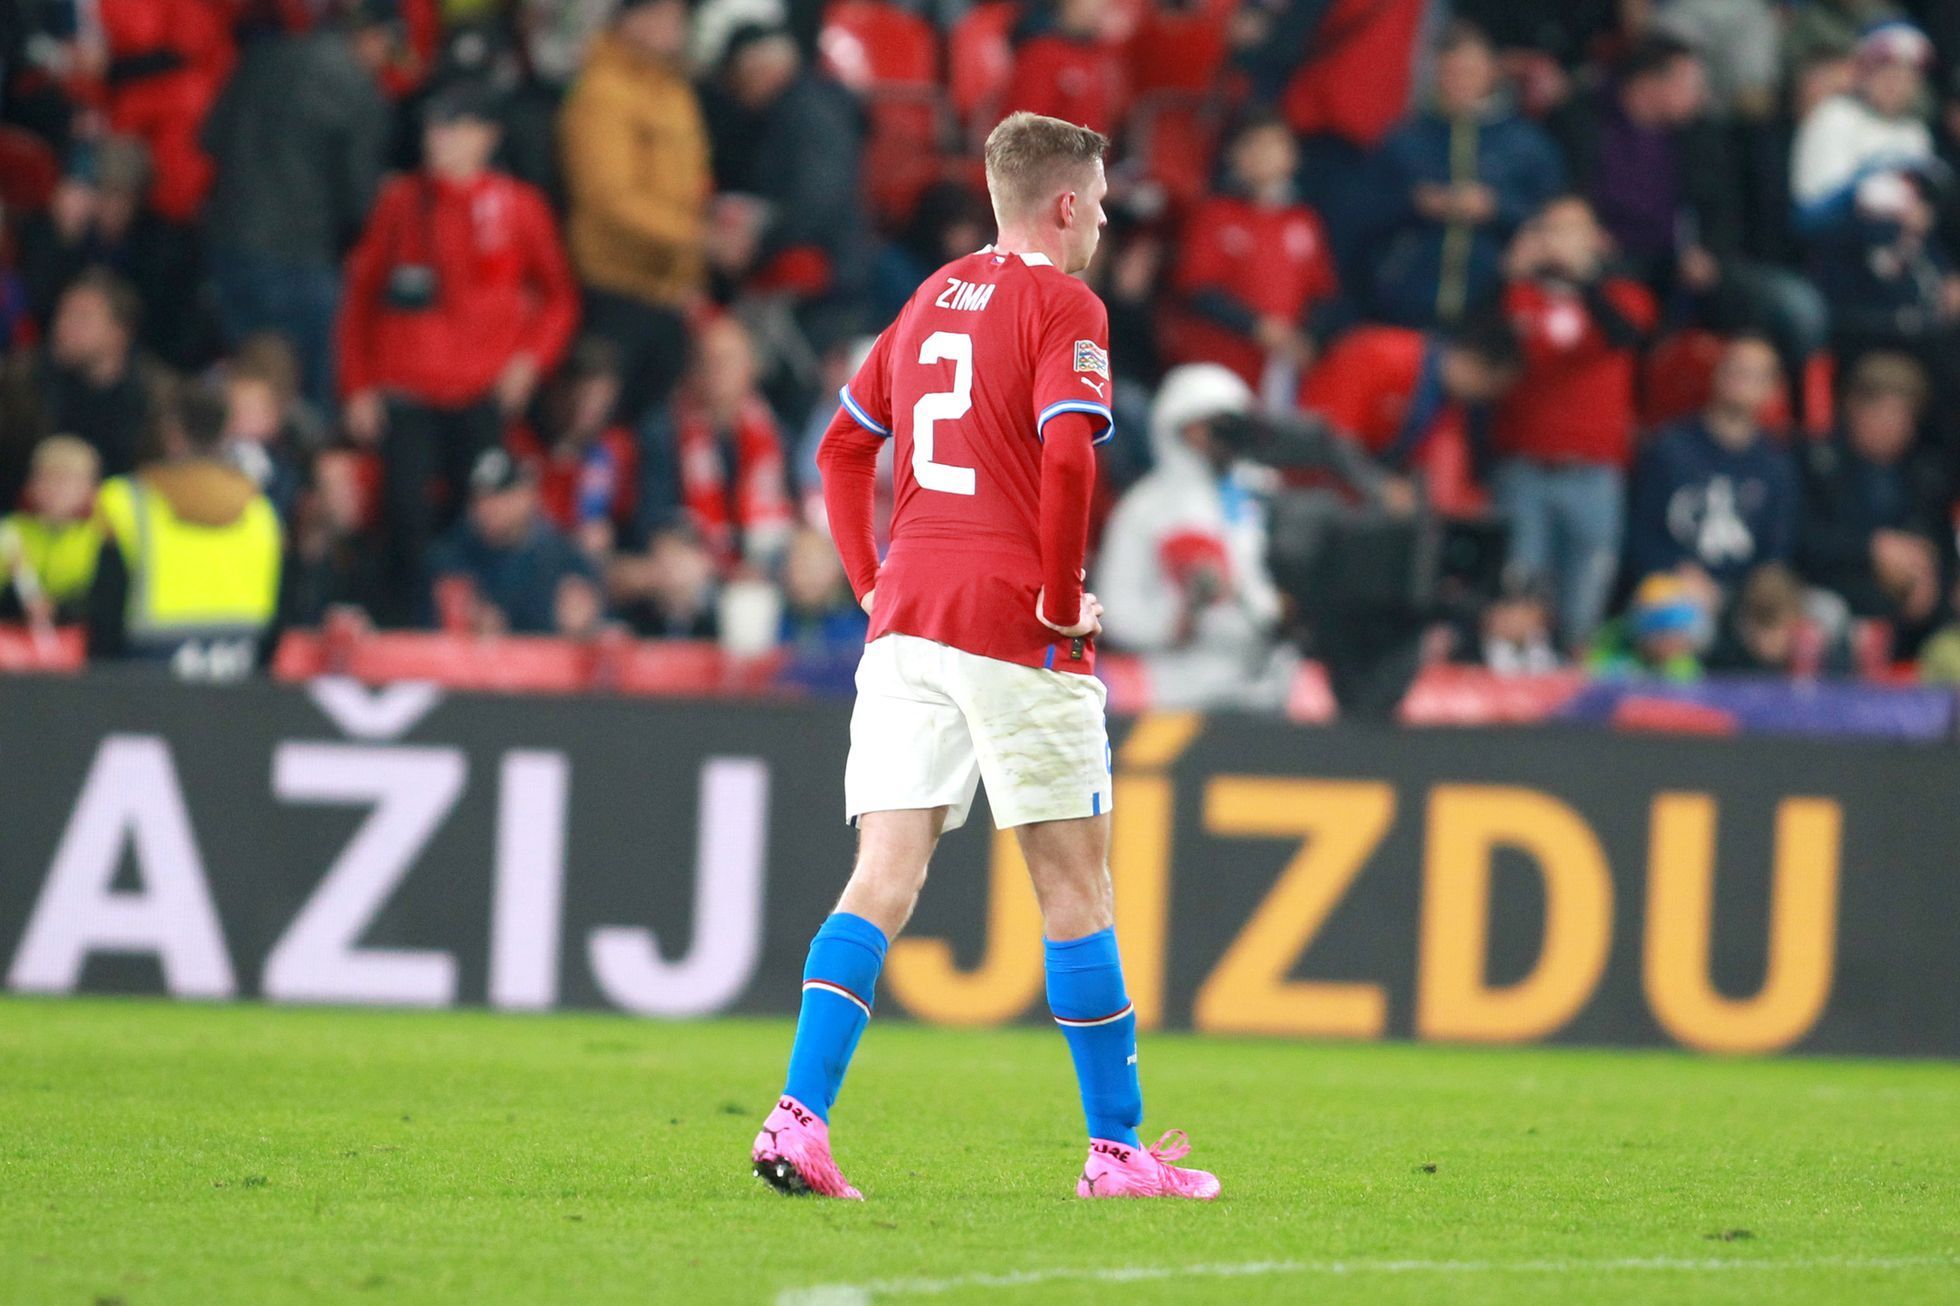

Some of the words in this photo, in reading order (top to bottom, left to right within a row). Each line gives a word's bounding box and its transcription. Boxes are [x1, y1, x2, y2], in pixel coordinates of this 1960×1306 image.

[935, 277, 996, 312] ZIMA
[911, 330, 976, 495] 2
[4, 677, 770, 1019] AŽIJ
[885, 713, 1844, 1055] JÍZDU
[1091, 1142, 1131, 1163] URE
